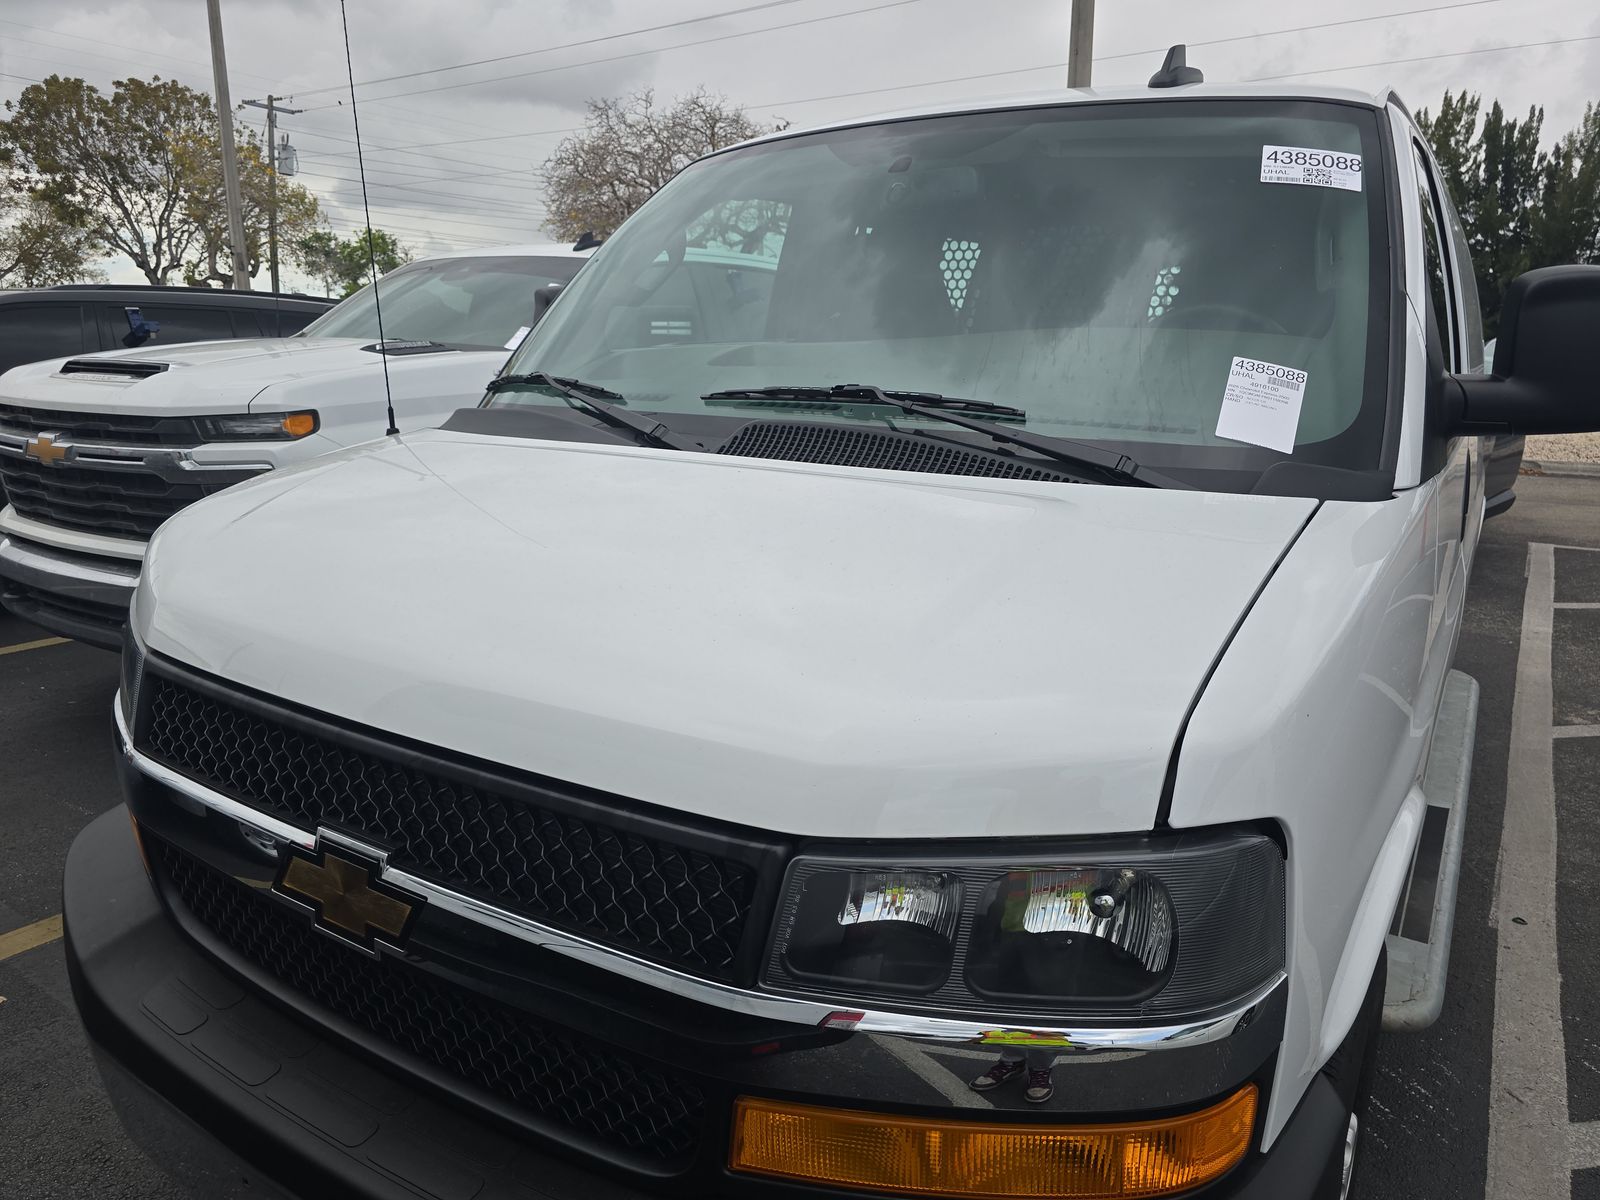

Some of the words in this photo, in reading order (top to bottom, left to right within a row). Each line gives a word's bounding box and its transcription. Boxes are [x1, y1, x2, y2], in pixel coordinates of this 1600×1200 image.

[1266, 150, 1361, 172] 4385088
[1231, 369, 1255, 380] UHAL
[1235, 360, 1305, 383] 4385088
